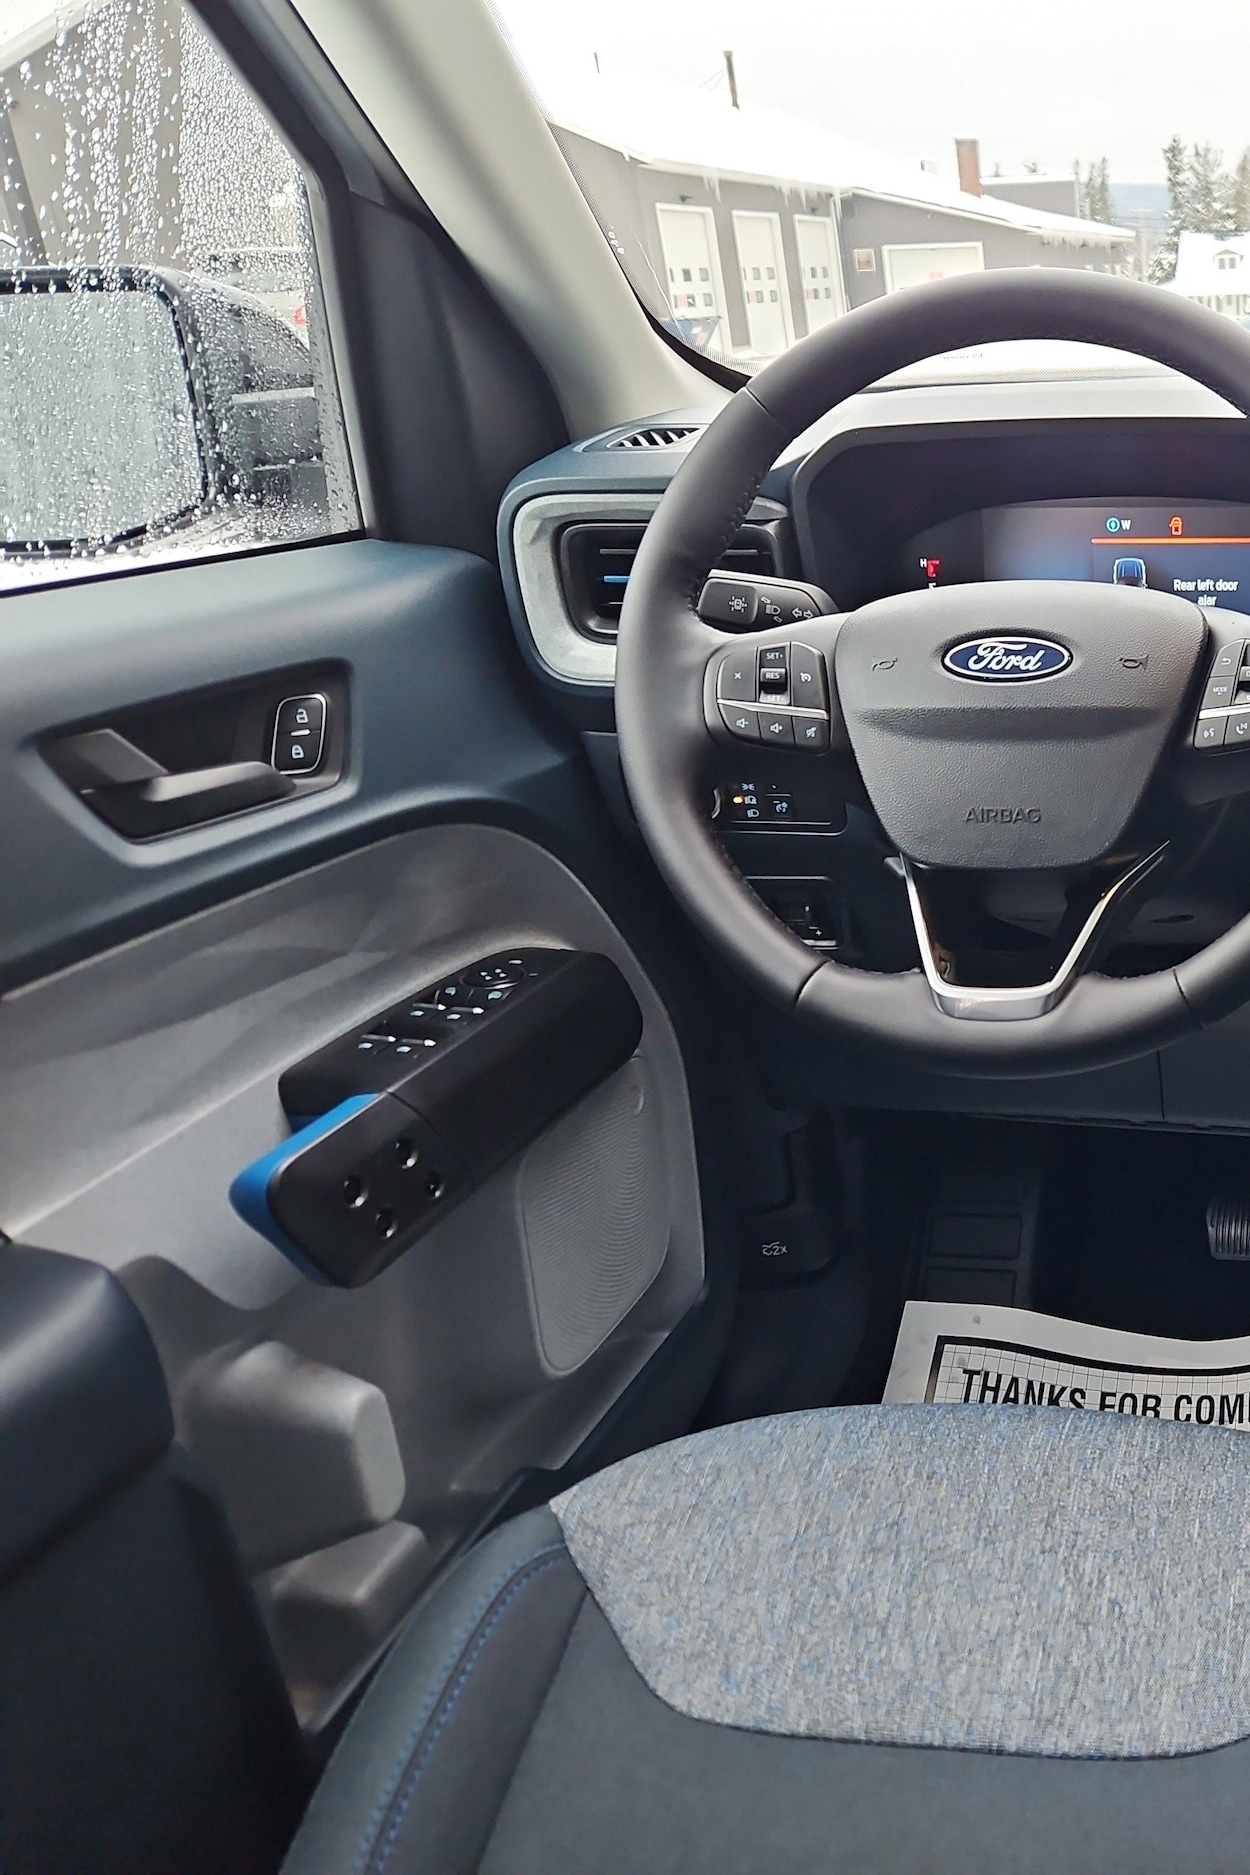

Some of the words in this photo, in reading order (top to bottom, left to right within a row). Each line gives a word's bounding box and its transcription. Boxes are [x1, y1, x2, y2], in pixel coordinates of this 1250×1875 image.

[1173, 578, 1197, 592] Rear
[1197, 578, 1215, 592] left
[1215, 578, 1239, 592] door
[1197, 595, 1217, 607] ajar
[965, 807, 1042, 824] AIRBAG
[962, 1369, 1086, 1409] THANKS
[1099, 1391, 1162, 1418] FOR
